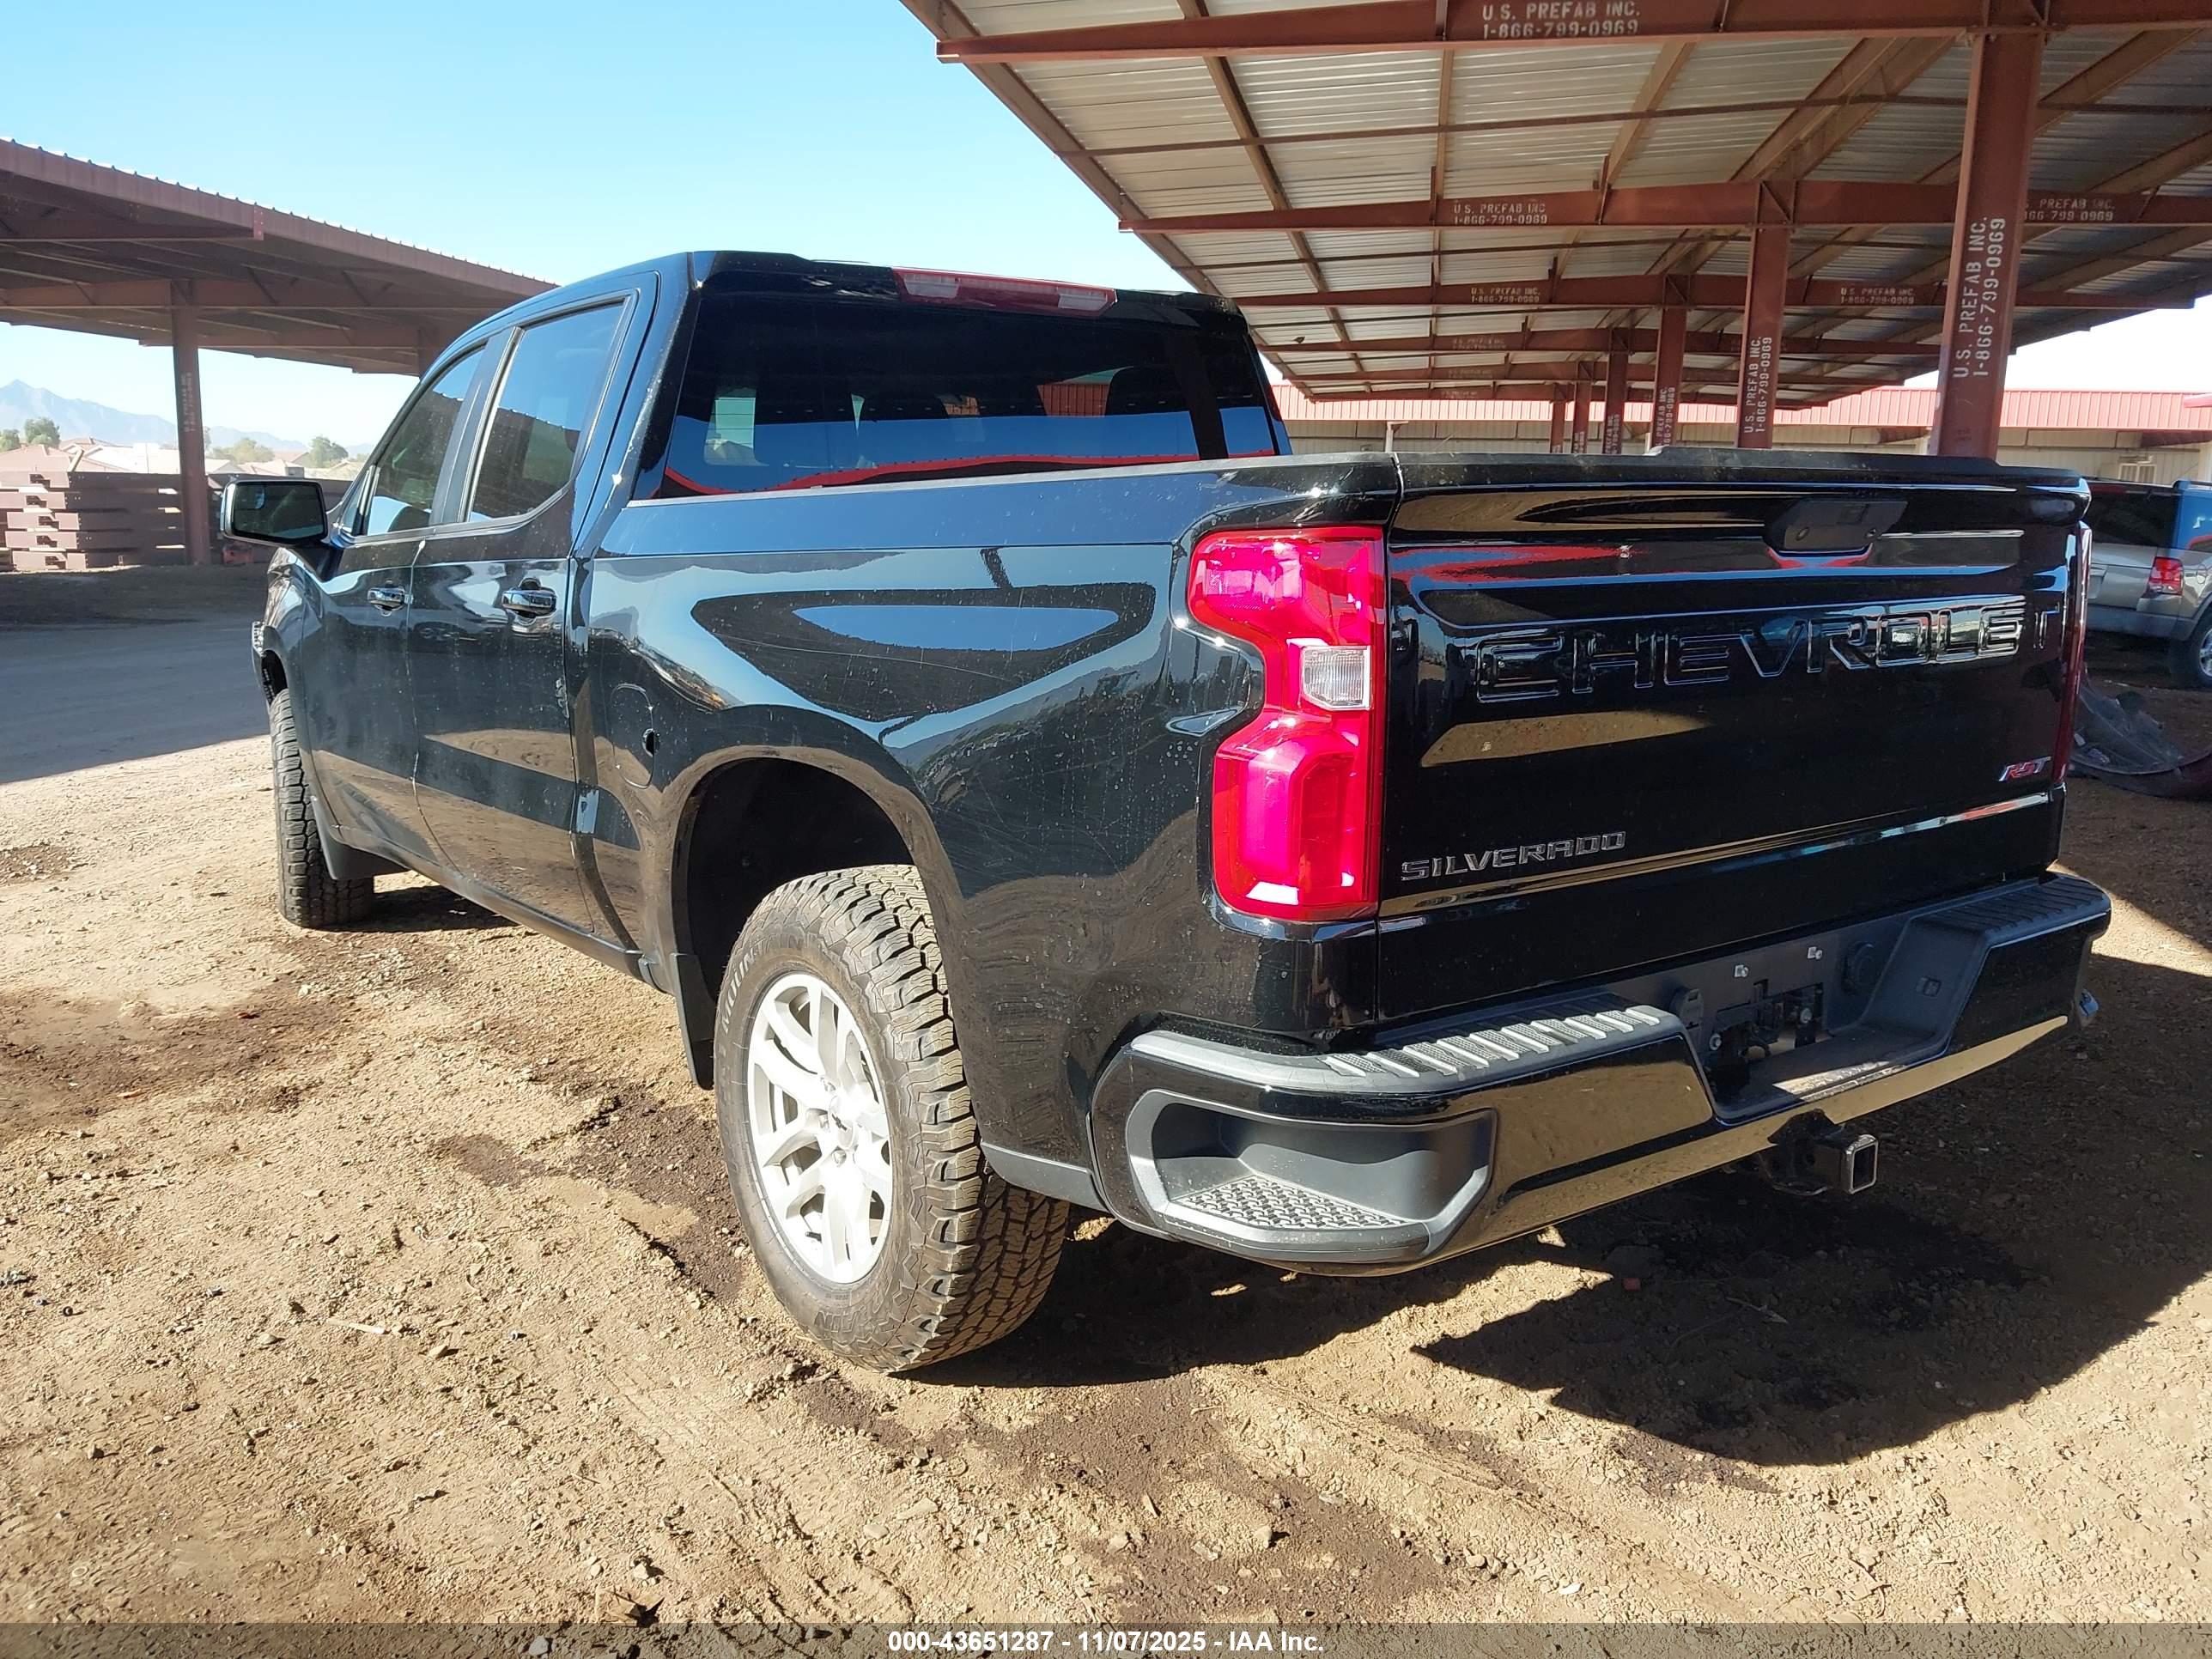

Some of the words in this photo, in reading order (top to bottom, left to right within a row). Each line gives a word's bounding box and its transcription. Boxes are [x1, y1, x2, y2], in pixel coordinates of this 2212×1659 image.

[1526, 2, 1596, 20] PREFAB
[1606, 1, 1640, 17] INC.
[1483, 19, 1638, 40] 1-866-799-0969
[1480, 203, 1522, 214] PREFAB
[2039, 198, 2087, 209] PREFAB
[1968, 216, 1988, 252] INC.
[1958, 261, 1982, 333] PREFAB
[1972, 217, 2006, 377] 1-866-799-0969
[1750, 337, 1762, 358] INC.
[1952, 344, 1973, 378] U.S.
[1746, 362, 1759, 406] PREFAB
[1755, 337, 1772, 432] 1-866-799-0969
[1743, 412, 1756, 433] U.S.
[1477, 596, 2060, 702] CHEVROLET
[1999, 756, 2051, 781] RST
[1401, 830, 1626, 881] SILVERADO
